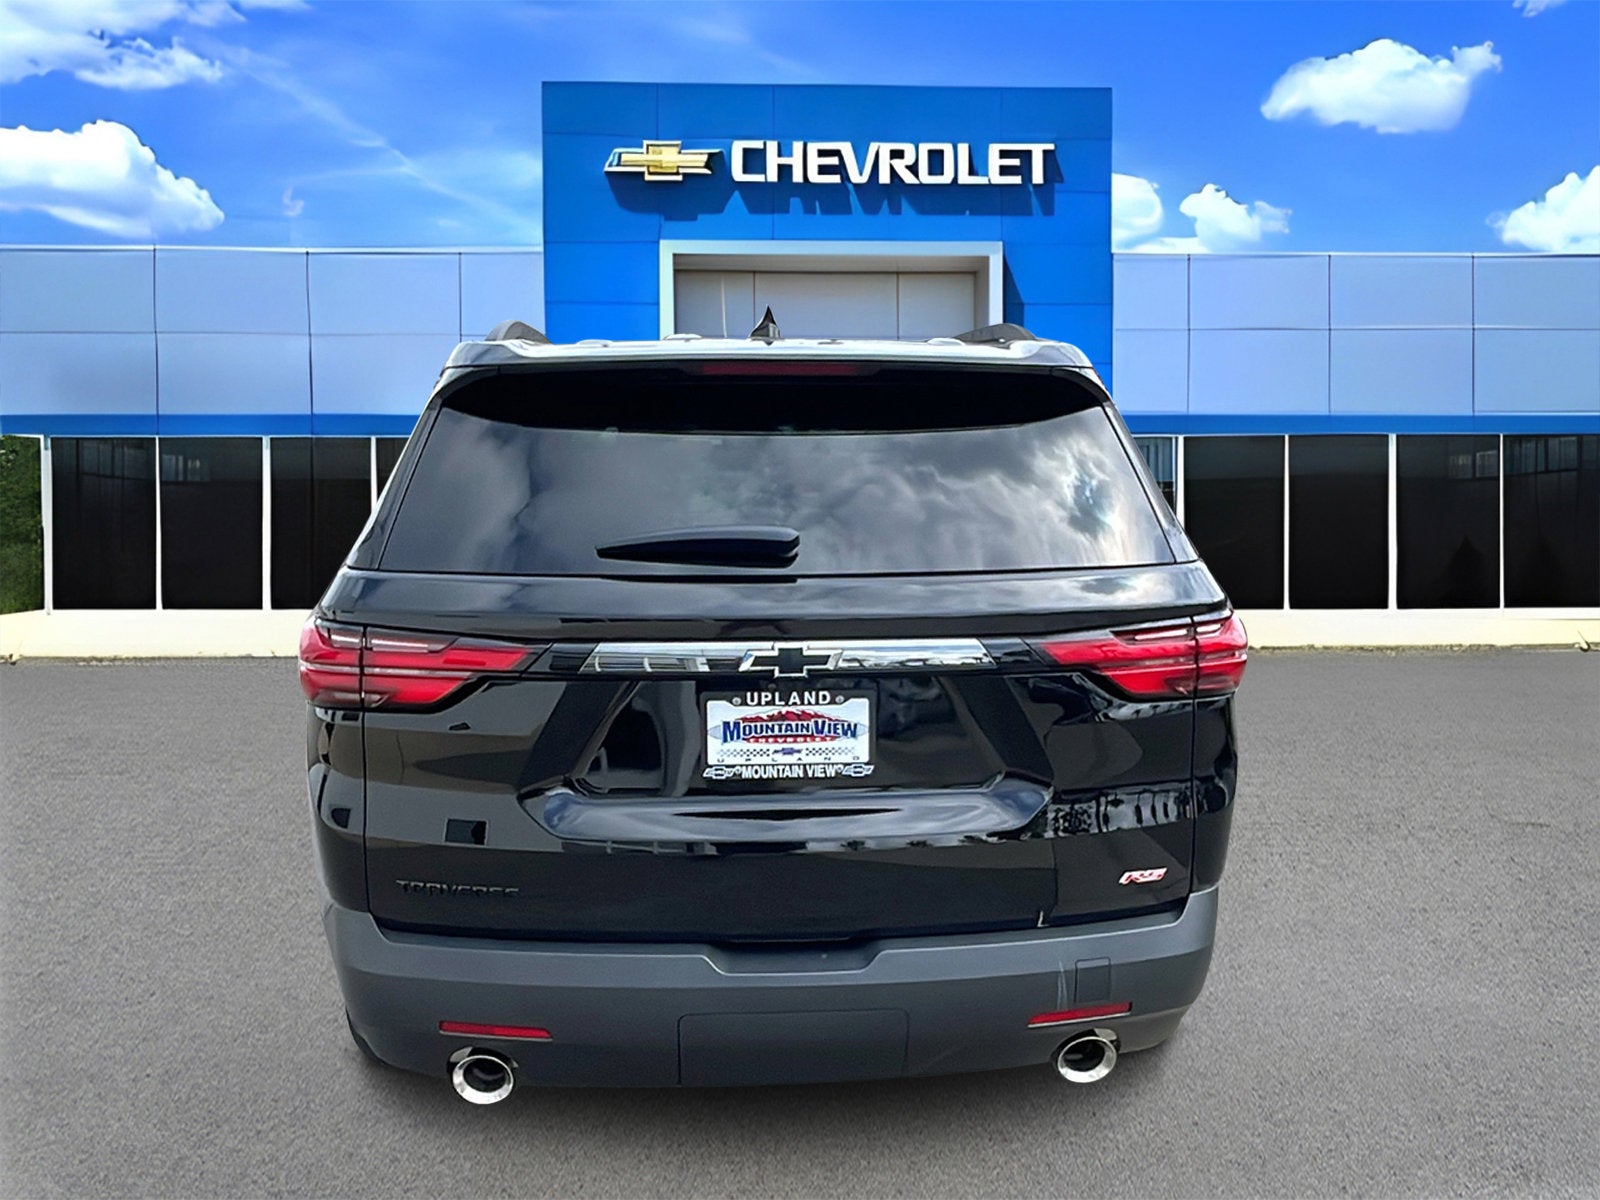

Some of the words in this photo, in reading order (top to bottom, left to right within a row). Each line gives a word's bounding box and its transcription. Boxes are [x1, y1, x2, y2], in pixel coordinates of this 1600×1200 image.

[731, 140, 1055, 185] CHEVROLET
[746, 691, 831, 706] UPLAND
[741, 765, 803, 779] MOUNTAIN
[806, 764, 837, 778] VIEW
